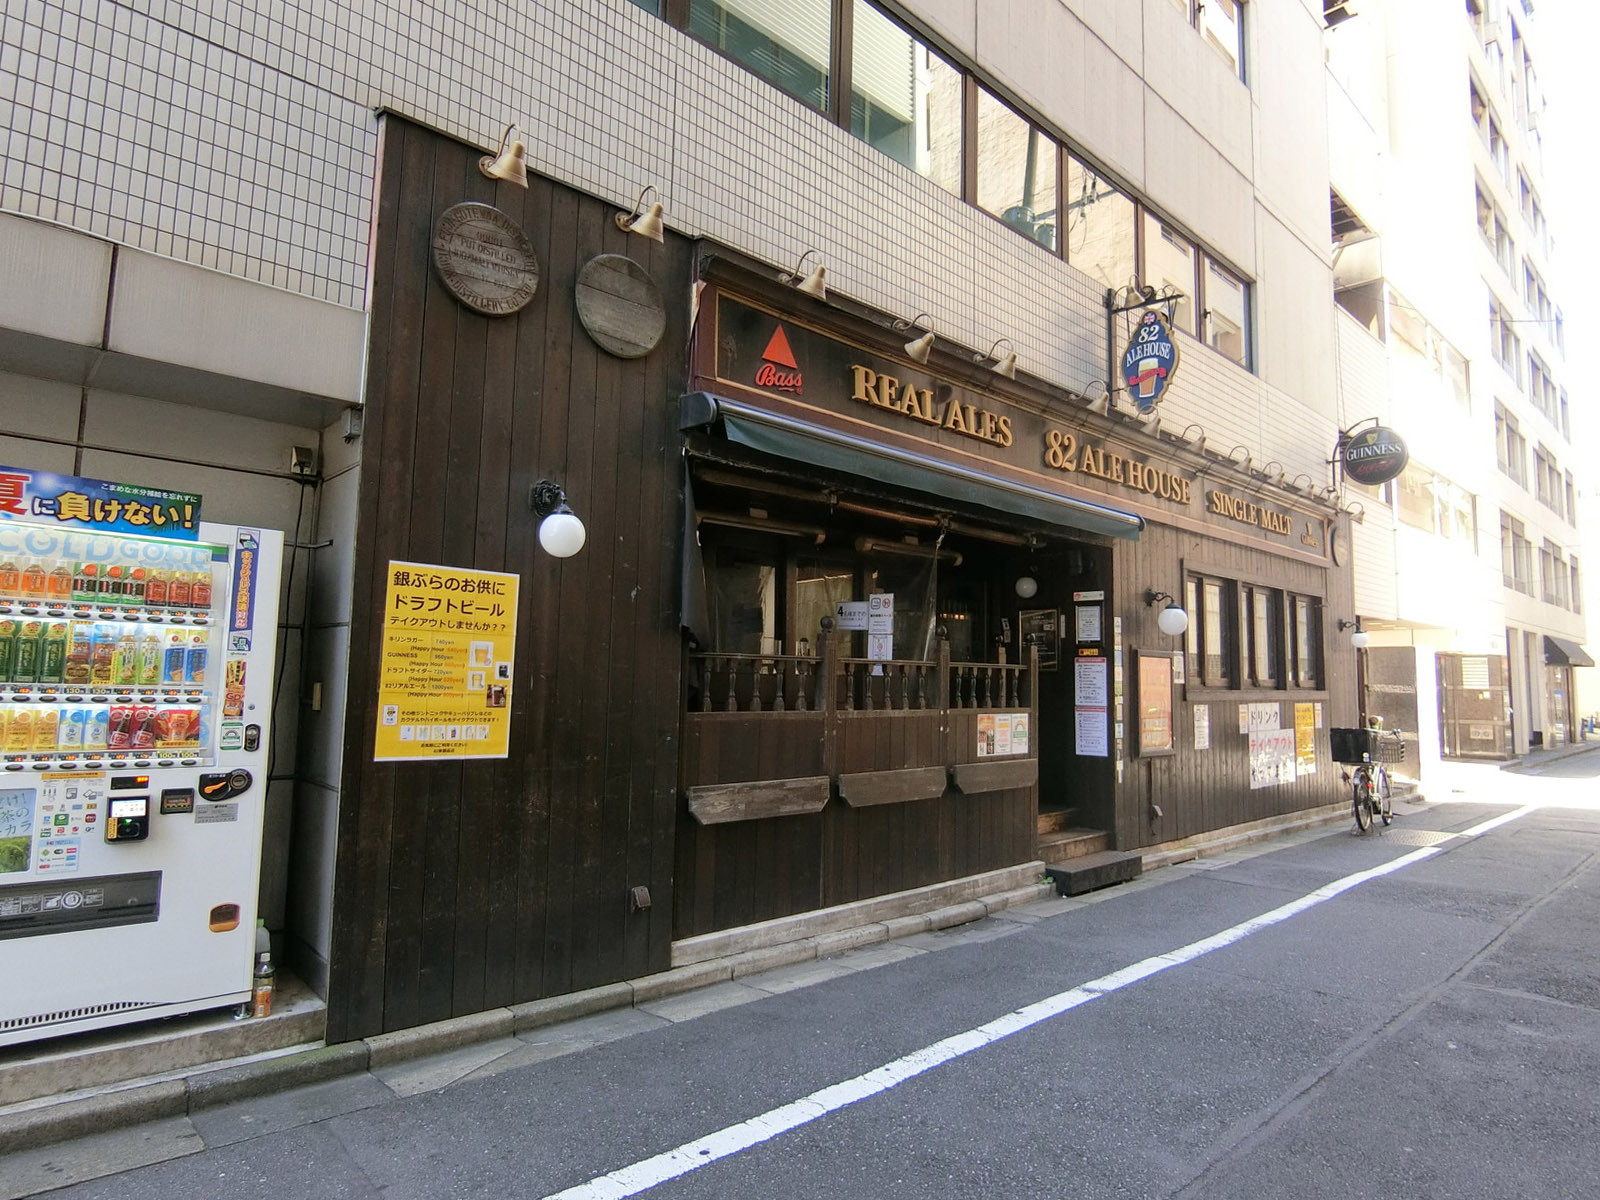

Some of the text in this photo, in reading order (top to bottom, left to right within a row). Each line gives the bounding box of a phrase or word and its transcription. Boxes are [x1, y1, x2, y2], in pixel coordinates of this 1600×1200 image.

[1138, 325, 1160, 343] 82
[1126, 341, 1172, 367] ALE HOUSE
[755, 364, 803, 395] Bass
[851, 364, 1013, 448] REAL ALES
[1346, 443, 1402, 461] GUINNESS
[1044, 429, 1192, 505] 82 ALE HOUSE
[1209, 490, 1293, 536] SINGLE MALT
[393, 571, 506, 596] 銀ぶらのお供に
[395, 594, 505, 617] ドラフトビール
[390, 616, 507, 631] テイクアウトしませんか？？
[1250, 710, 1279, 726] ドリンク
